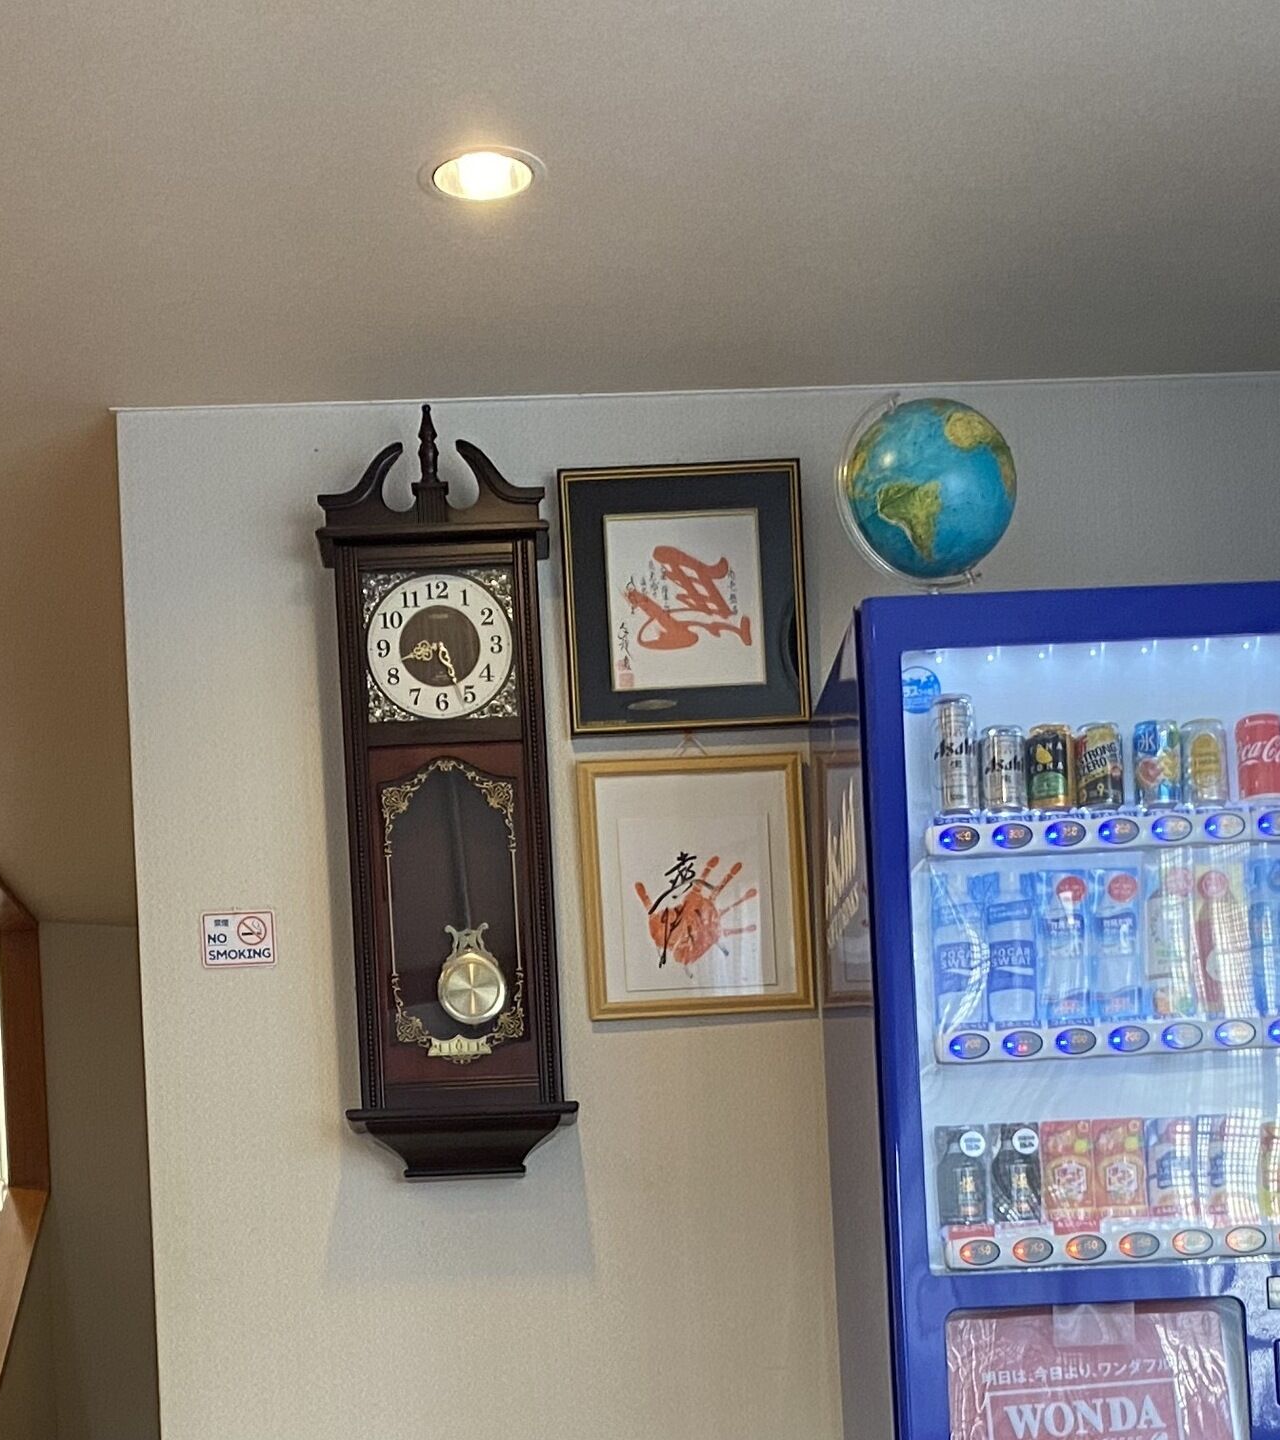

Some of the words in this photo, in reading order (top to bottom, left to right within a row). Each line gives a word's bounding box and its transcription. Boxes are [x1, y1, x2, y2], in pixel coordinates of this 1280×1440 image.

[400, 591, 420, 608] 11
[426, 581, 449, 600] 12
[461, 589, 470, 606] 1
[378, 611, 403, 629] 10
[480, 608, 494, 626] 2
[376, 639, 391, 658] 9
[490, 635, 503, 654] 3
[387, 667, 400, 685] 8
[479, 664, 495, 682] 4
[409, 688, 421, 705] 7
[435, 692, 449, 711] 6
[463, 685, 476, 703] 5
[1079, 757, 1107, 777] ZERO
[208, 933, 227, 944] NO
[209, 948, 271, 960] SMOKING
[1004, 1394, 1166, 1440] WONDA
